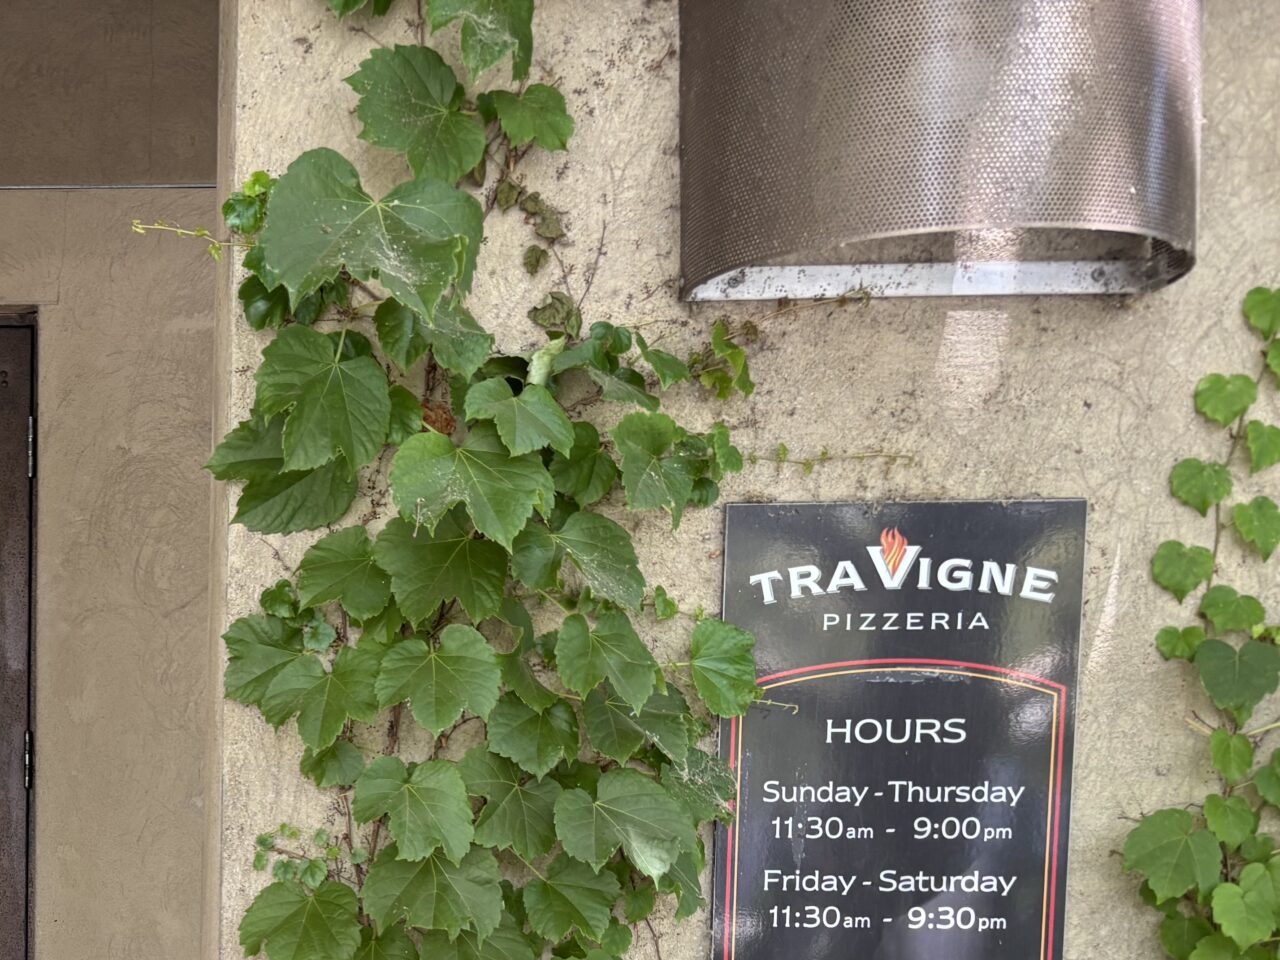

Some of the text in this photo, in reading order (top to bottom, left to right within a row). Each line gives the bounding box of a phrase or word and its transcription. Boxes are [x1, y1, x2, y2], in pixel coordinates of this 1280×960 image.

[822, 612, 990, 631] PIZZERIA
[825, 718, 967, 744] HOURS
[762, 780, 869, 806] Sunday
[888, 780, 1025, 806] Thursday
[763, 869, 857, 896] Friday
[878, 869, 1017, 896] Saturday
